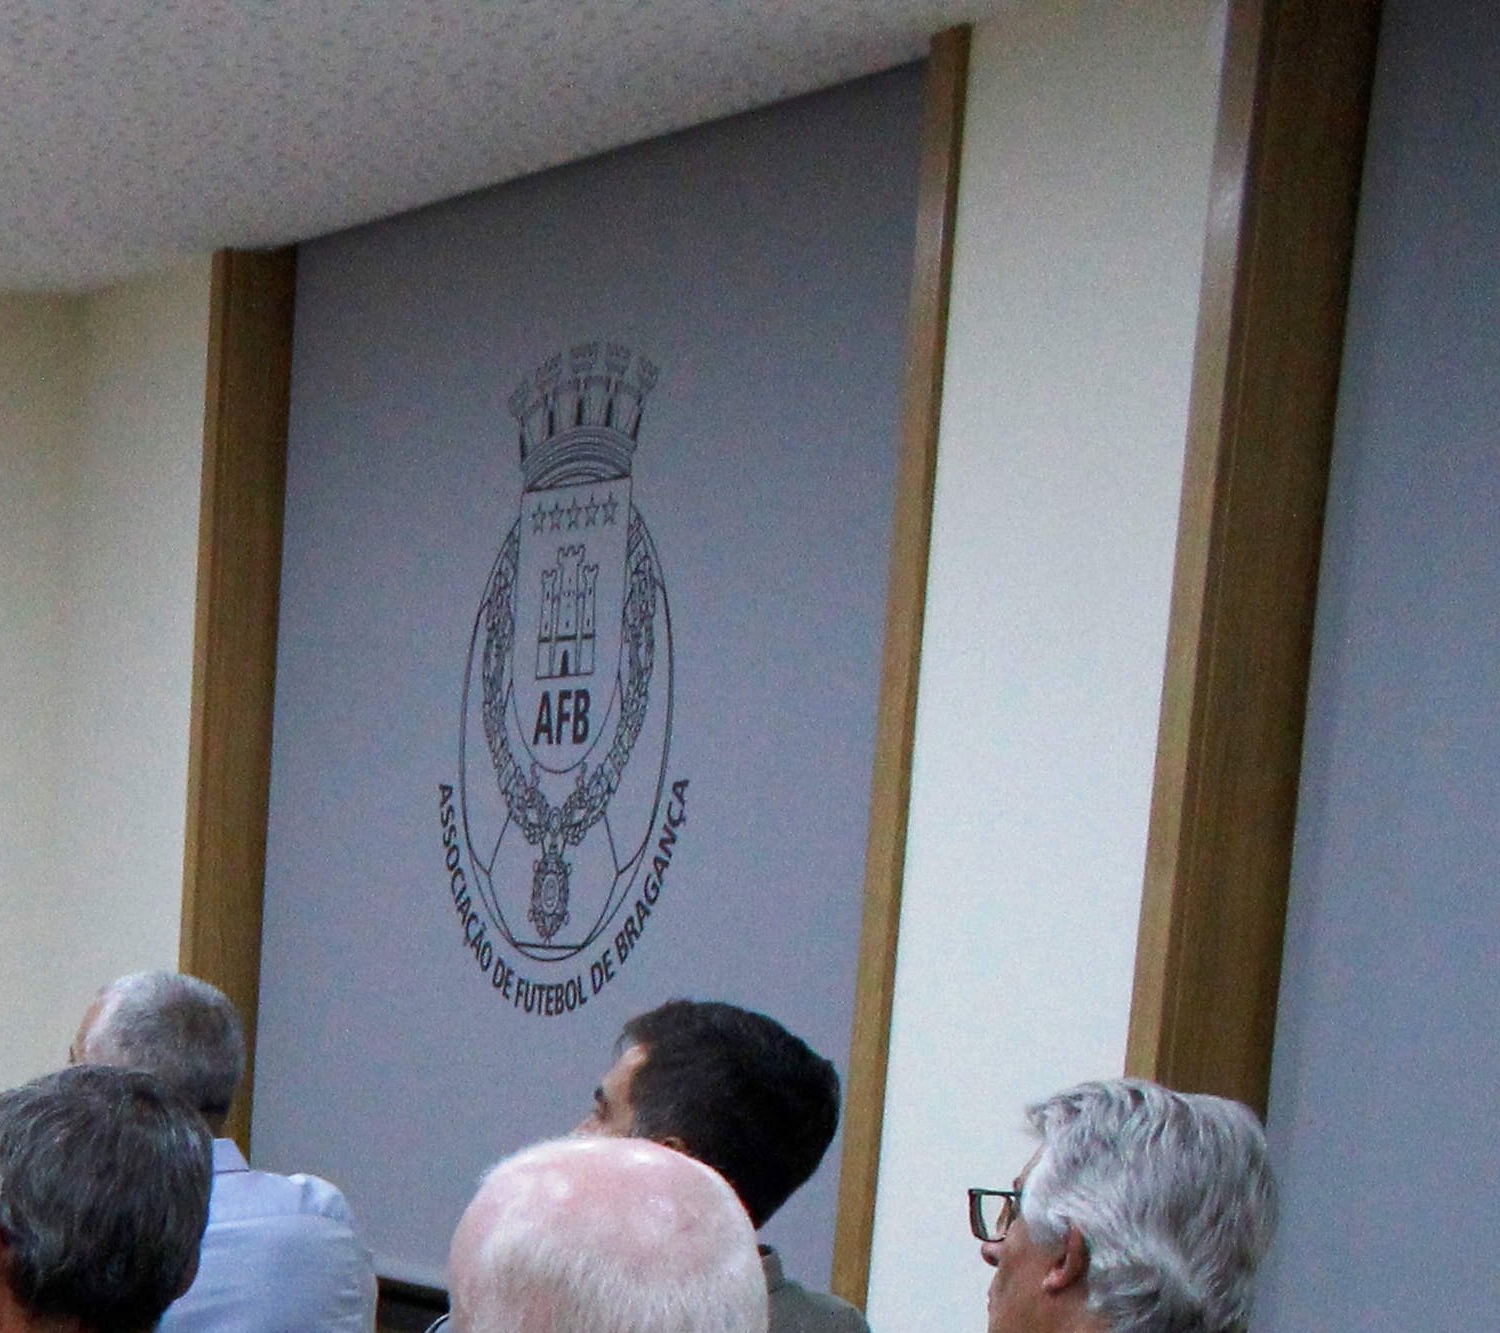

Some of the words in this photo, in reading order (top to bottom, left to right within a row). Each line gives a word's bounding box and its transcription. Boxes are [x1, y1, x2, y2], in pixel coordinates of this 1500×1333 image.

[532, 688, 591, 746] AFB
[438, 783, 493, 972] ASSOCIAÇÃO
[491, 956, 515, 1001] DE
[514, 974, 588, 1016] FUTEBOL
[590, 948, 616, 995] DE
[614, 778, 690, 965] BRAGANÇA
